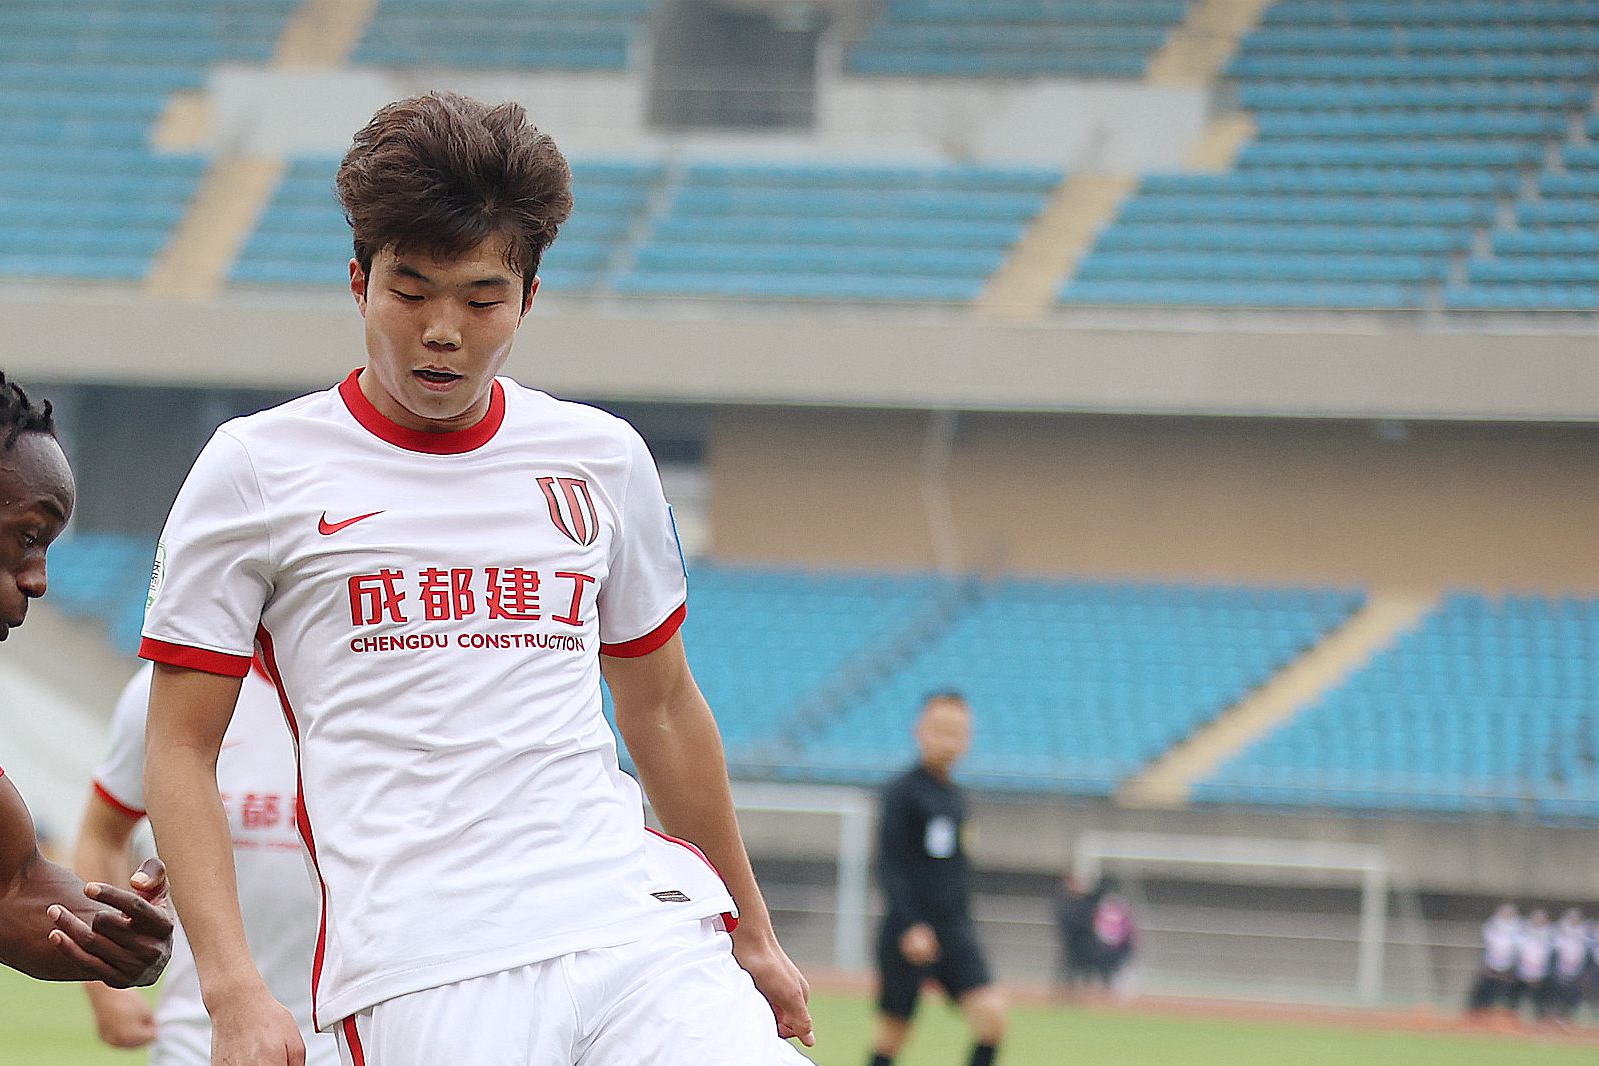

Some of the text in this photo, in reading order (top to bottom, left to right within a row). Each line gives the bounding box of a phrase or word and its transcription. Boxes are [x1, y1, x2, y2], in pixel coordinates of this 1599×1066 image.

[348, 567, 596, 626] 成都建工
[350, 633, 586, 653] CHENGDU CONSTRUCTION
